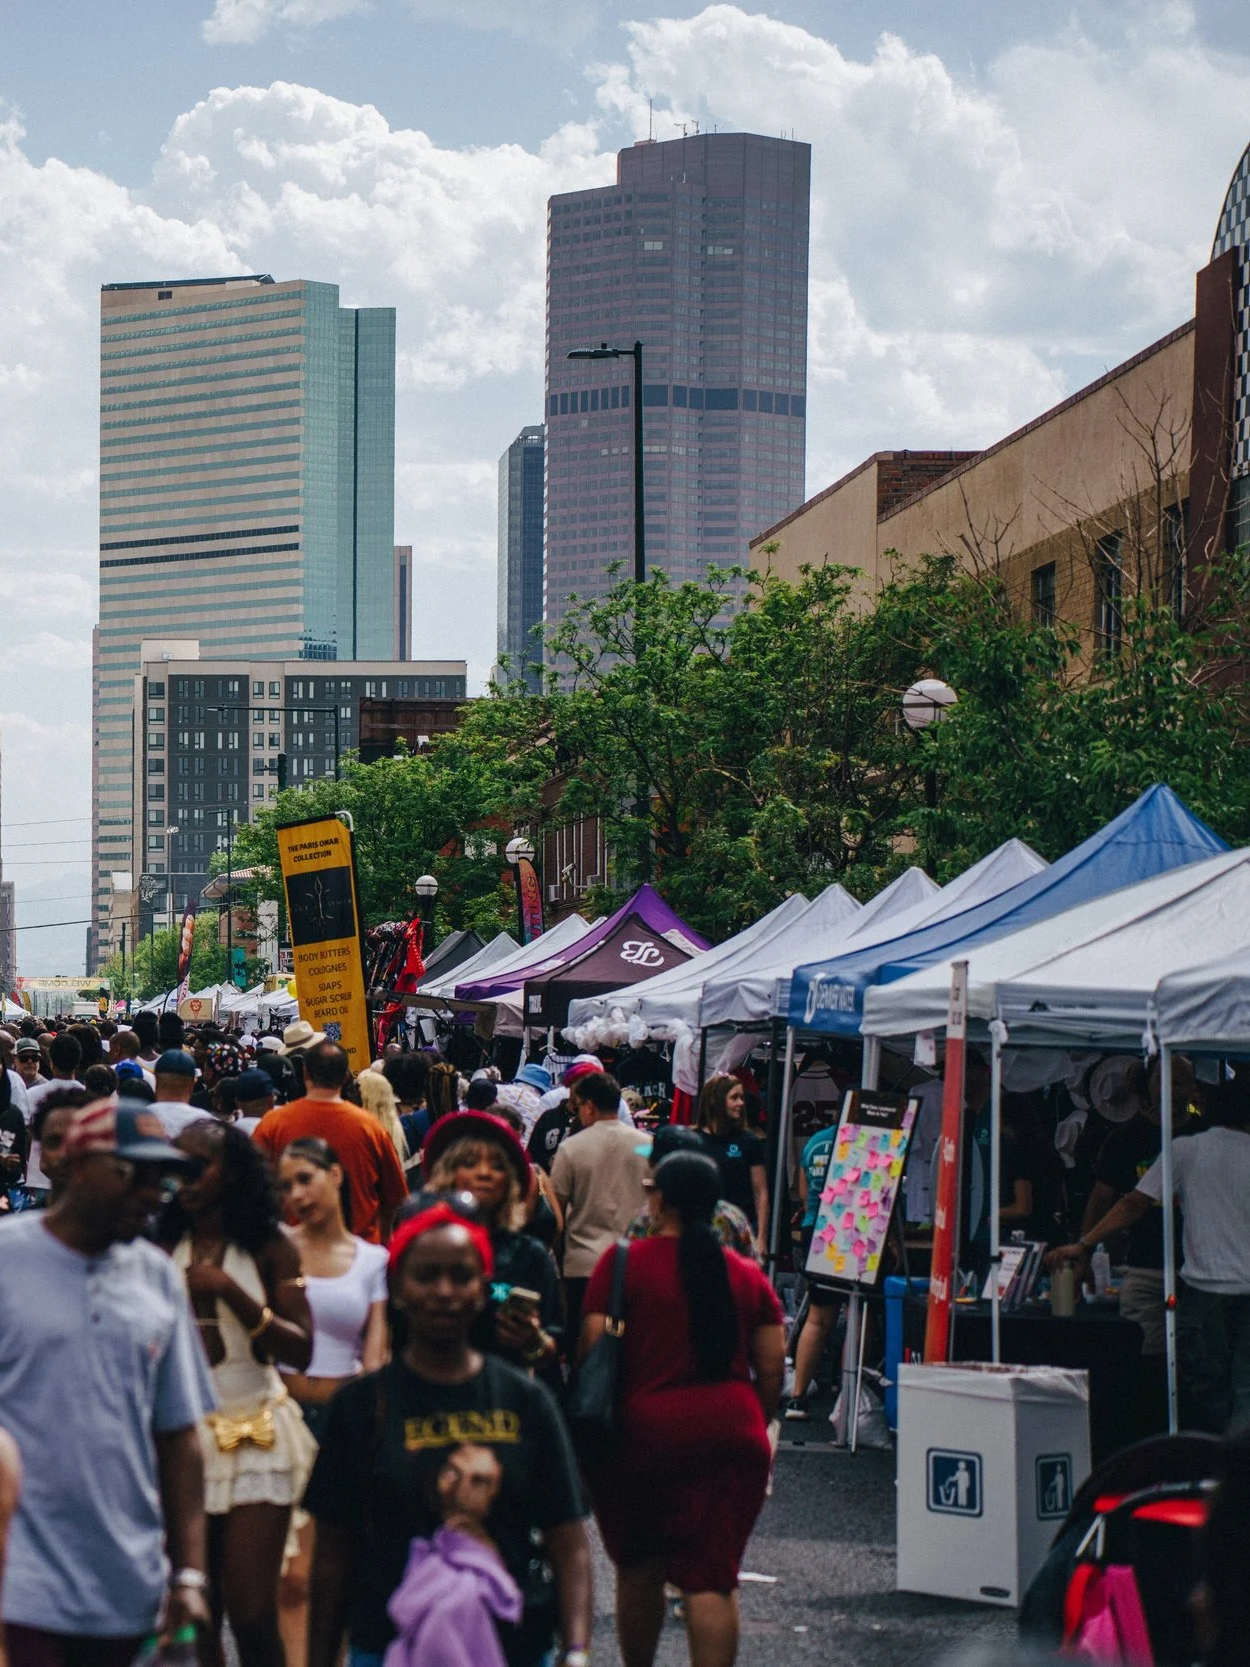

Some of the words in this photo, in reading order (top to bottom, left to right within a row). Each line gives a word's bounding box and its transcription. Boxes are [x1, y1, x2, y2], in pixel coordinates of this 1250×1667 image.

[287, 845, 299, 853] THE
[299, 842, 319, 851] PARIS
[319, 837, 339, 848] OMAR
[293, 850, 332, 863] COLLECTION
[298, 952, 319, 963] BODY
[319, 947, 351, 960] BUTTERS
[308, 963, 348, 976] COLOGNES
[318, 980, 342, 992] SOAPS
[305, 996, 328, 1007] SUGAR
[329, 992, 352, 1003] SCRUB
[314, 1007, 338, 1019] BEARD
